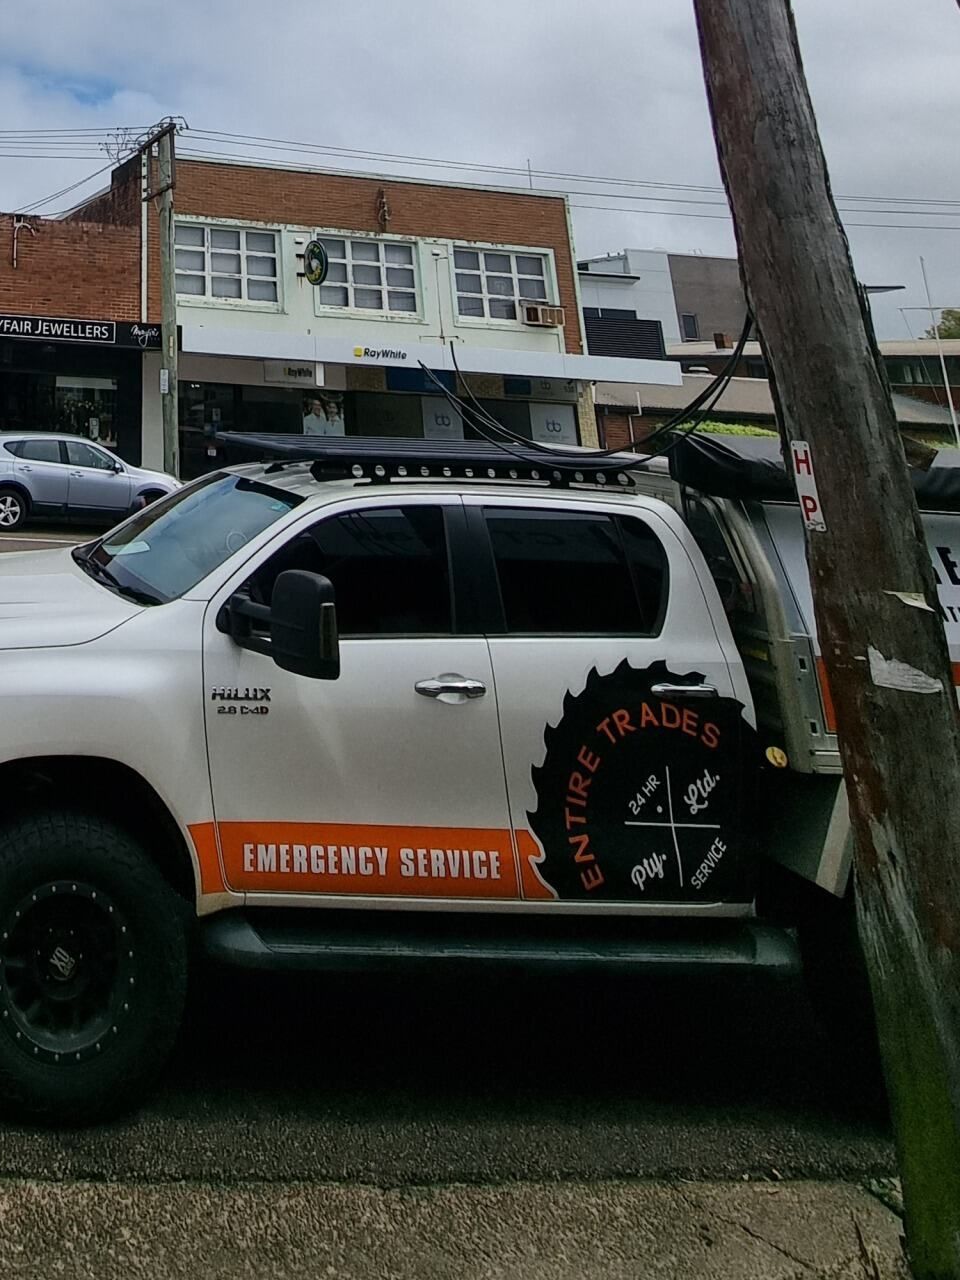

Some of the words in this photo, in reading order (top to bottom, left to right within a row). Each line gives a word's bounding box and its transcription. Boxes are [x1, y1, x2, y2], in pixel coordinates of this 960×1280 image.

[34, 319, 109, 339] JEWELLERS
[564, 744, 605, 891] ENTIRE
[595, 701, 721, 749] TRADES
[628, 792, 646, 815] 24
[642, 774, 661, 797] HR
[243, 843, 389, 876] EMERGENCY
[399, 848, 501, 879] SERVICE
[690, 837, 727, 890] SERVICE
